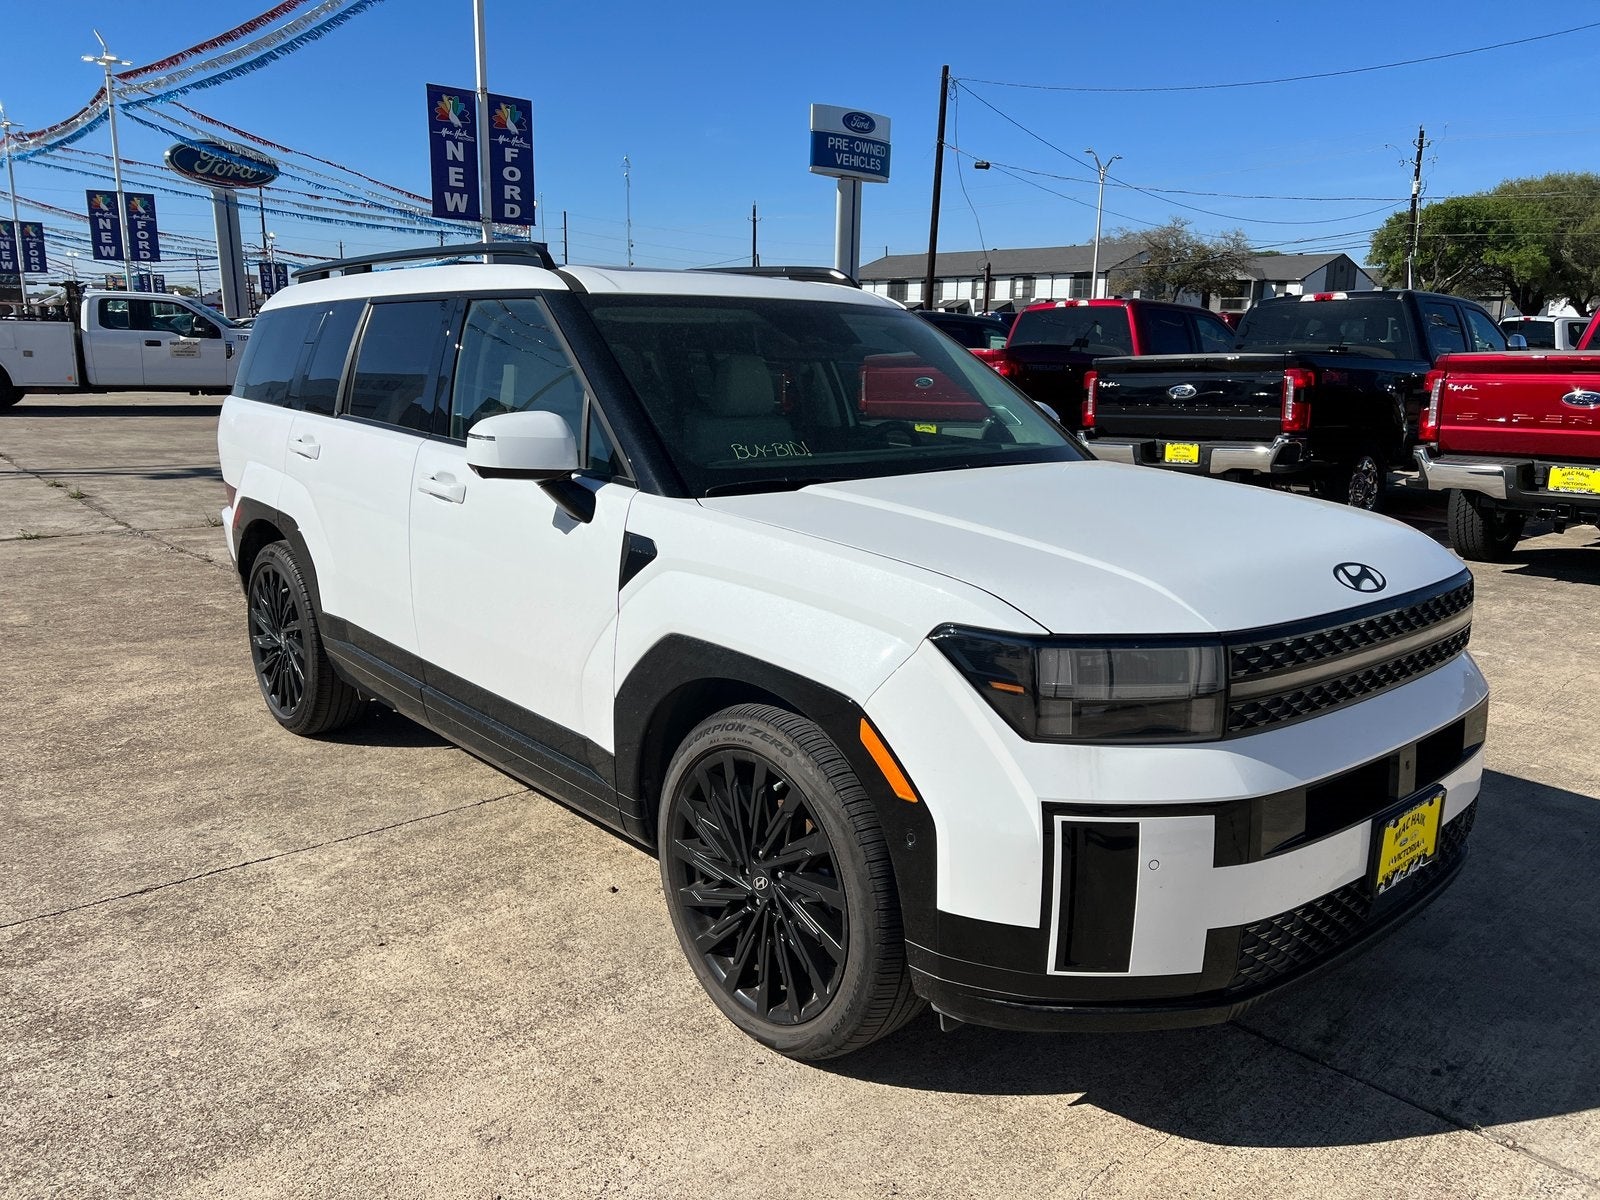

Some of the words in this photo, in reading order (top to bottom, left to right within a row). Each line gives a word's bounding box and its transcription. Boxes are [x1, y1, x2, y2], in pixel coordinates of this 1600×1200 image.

[850, 115, 870, 129] Ford
[827, 136, 887, 158] PRE-OWNED
[835, 152, 881, 171] VEHICLES
[444, 140, 468, 213] NEW
[502, 147, 522, 219] FORD
[98, 218, 116, 257] NEW
[136, 220, 151, 260] FORD
[0, 240, 13, 270] NEW
[29, 242, 41, 272] FORD
[748, 728, 795, 759] ZERO
